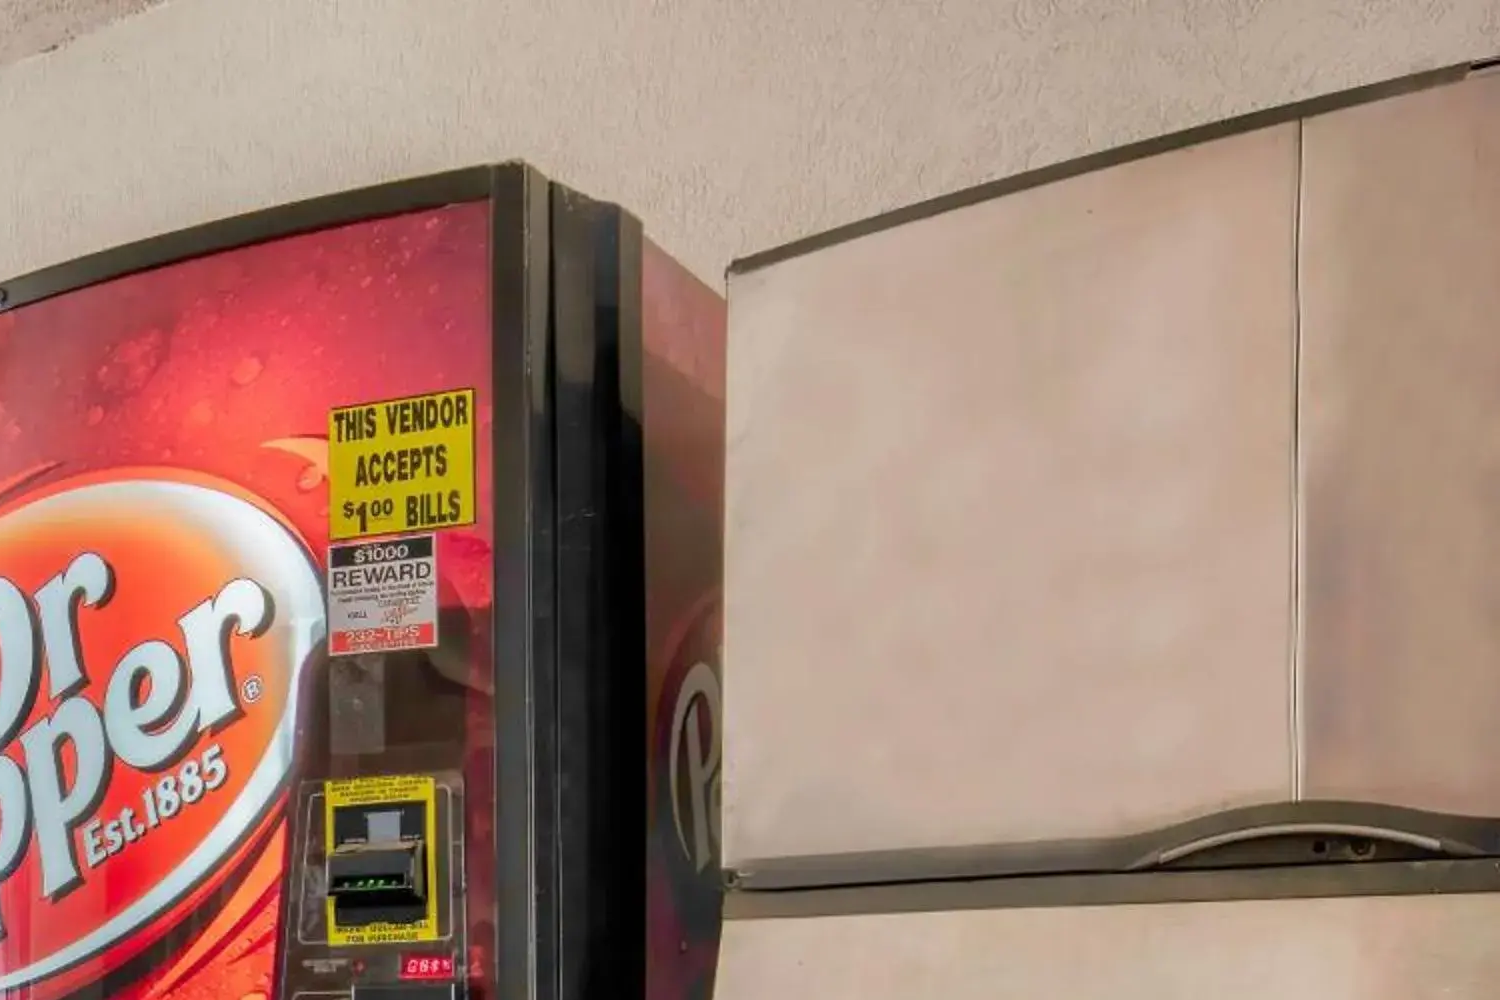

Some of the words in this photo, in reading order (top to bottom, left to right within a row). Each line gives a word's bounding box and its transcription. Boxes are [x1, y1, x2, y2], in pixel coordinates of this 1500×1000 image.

[334, 406, 377, 444] THIS
[386, 394, 468, 436] VENDOR
[355, 445, 447, 487] ACCEPTS
[406, 490, 461, 527] BILLS
[353, 544, 409, 563] $1000
[332, 561, 431, 588] REWARD
